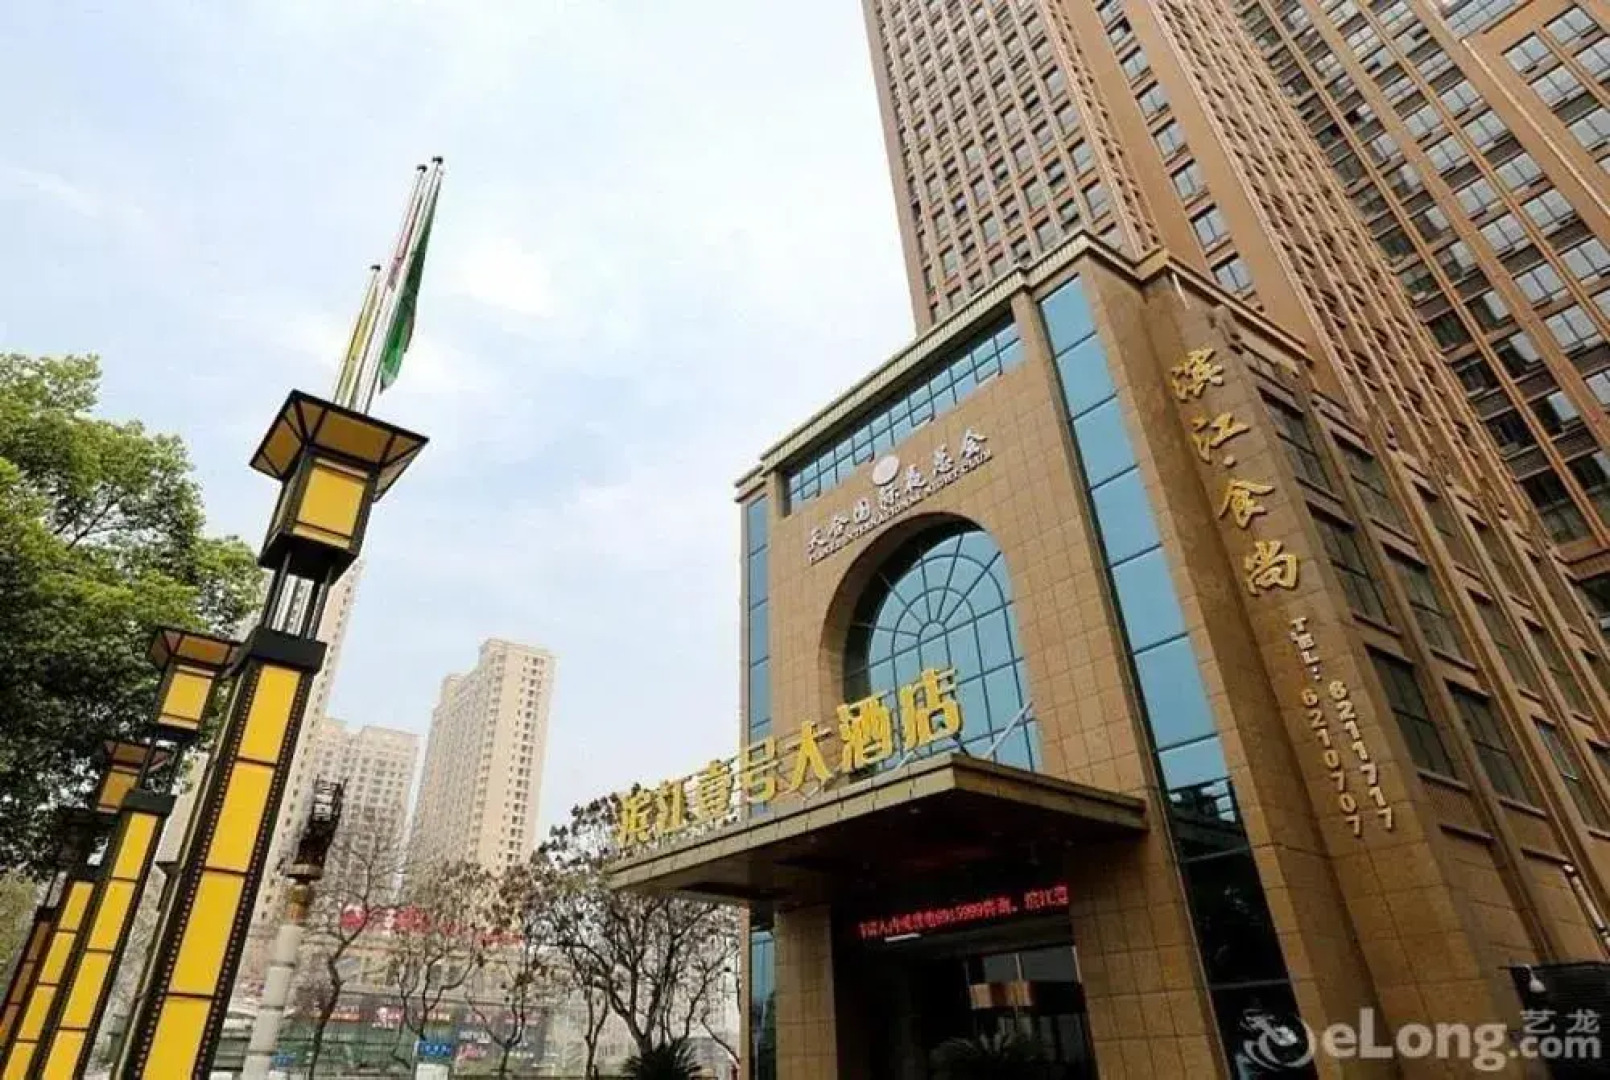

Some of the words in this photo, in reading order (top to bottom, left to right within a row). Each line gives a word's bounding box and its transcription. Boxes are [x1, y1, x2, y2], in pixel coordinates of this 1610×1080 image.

[617, 667, 964, 848] 滨江壹号大酒店
